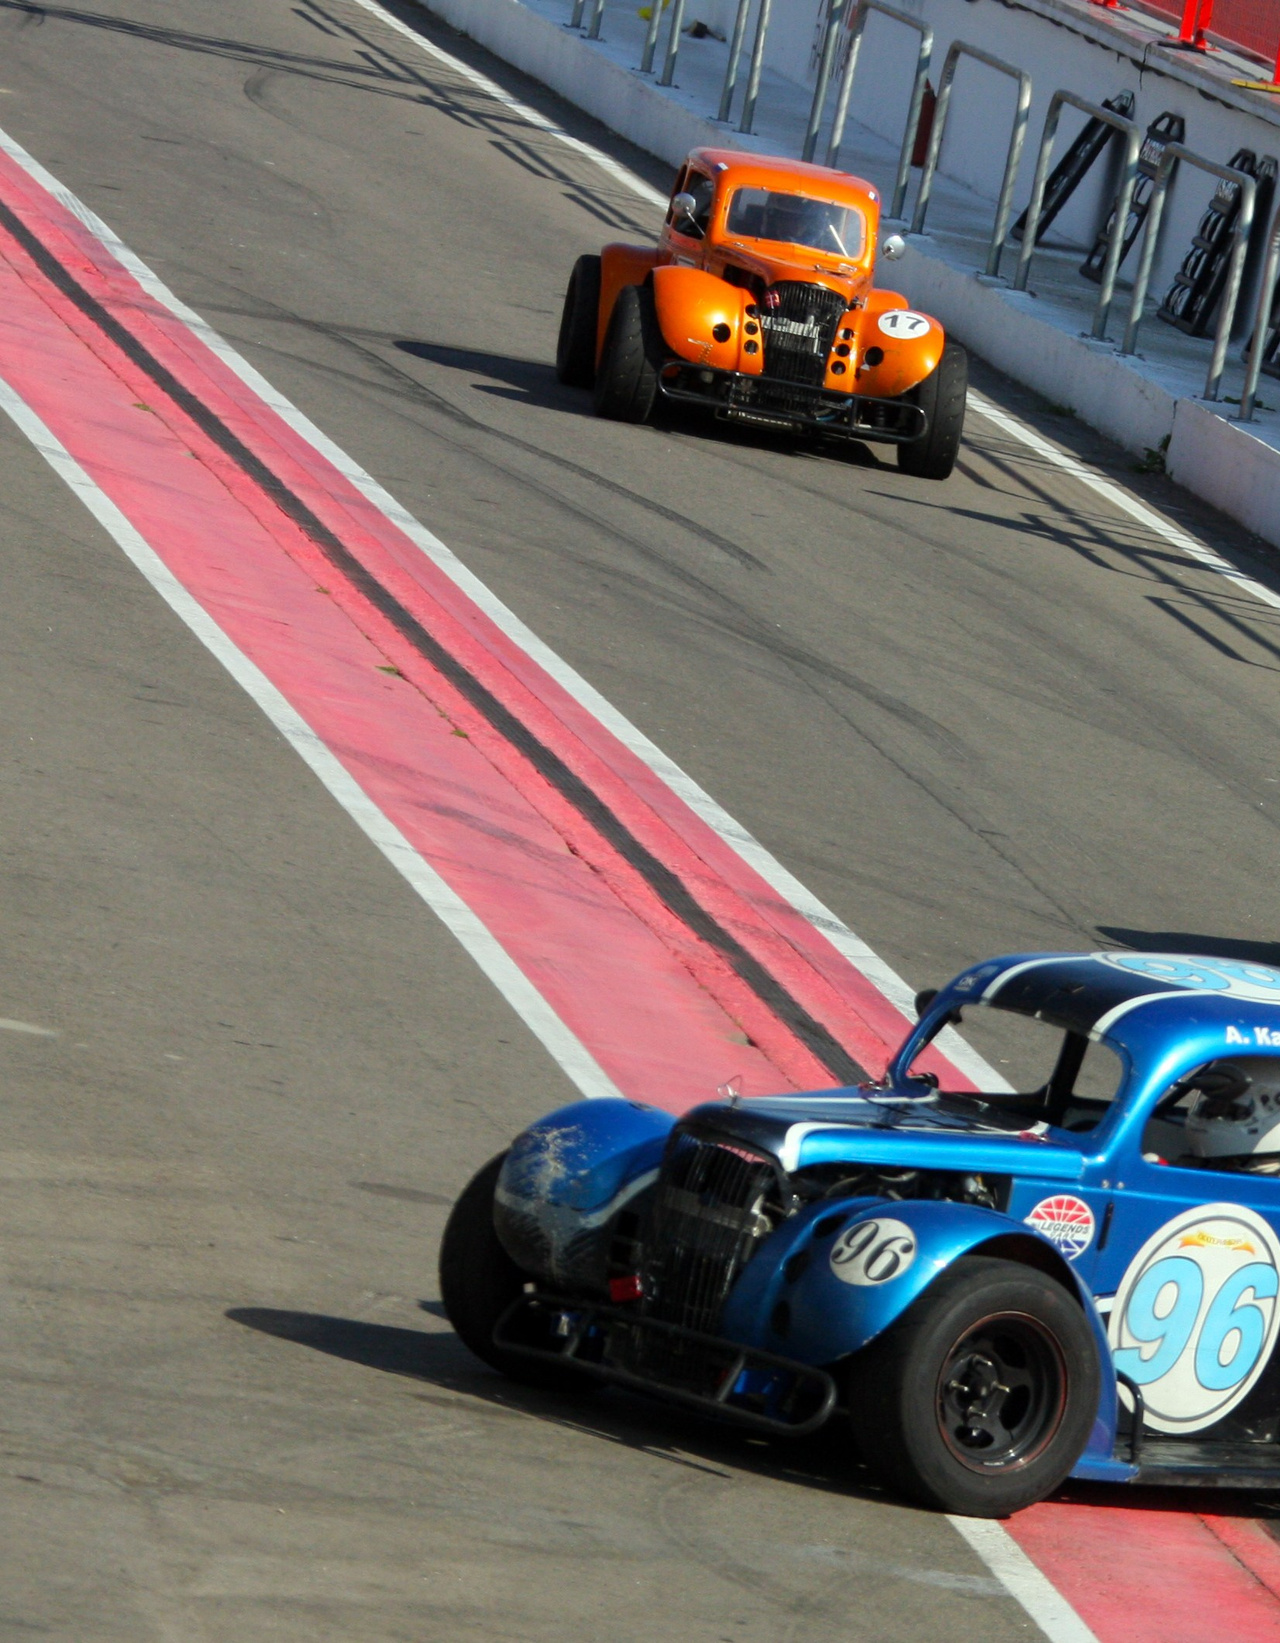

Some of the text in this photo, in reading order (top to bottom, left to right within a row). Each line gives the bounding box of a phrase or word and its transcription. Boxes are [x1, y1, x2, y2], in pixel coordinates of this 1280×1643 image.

[884, 314, 925, 330] 17
[1225, 1025, 1250, 1045] А.
[1040, 1221, 1091, 1235] LEGENDS
[830, 1221, 914, 1281] 96
[1112, 1255, 1280, 1392] 96
